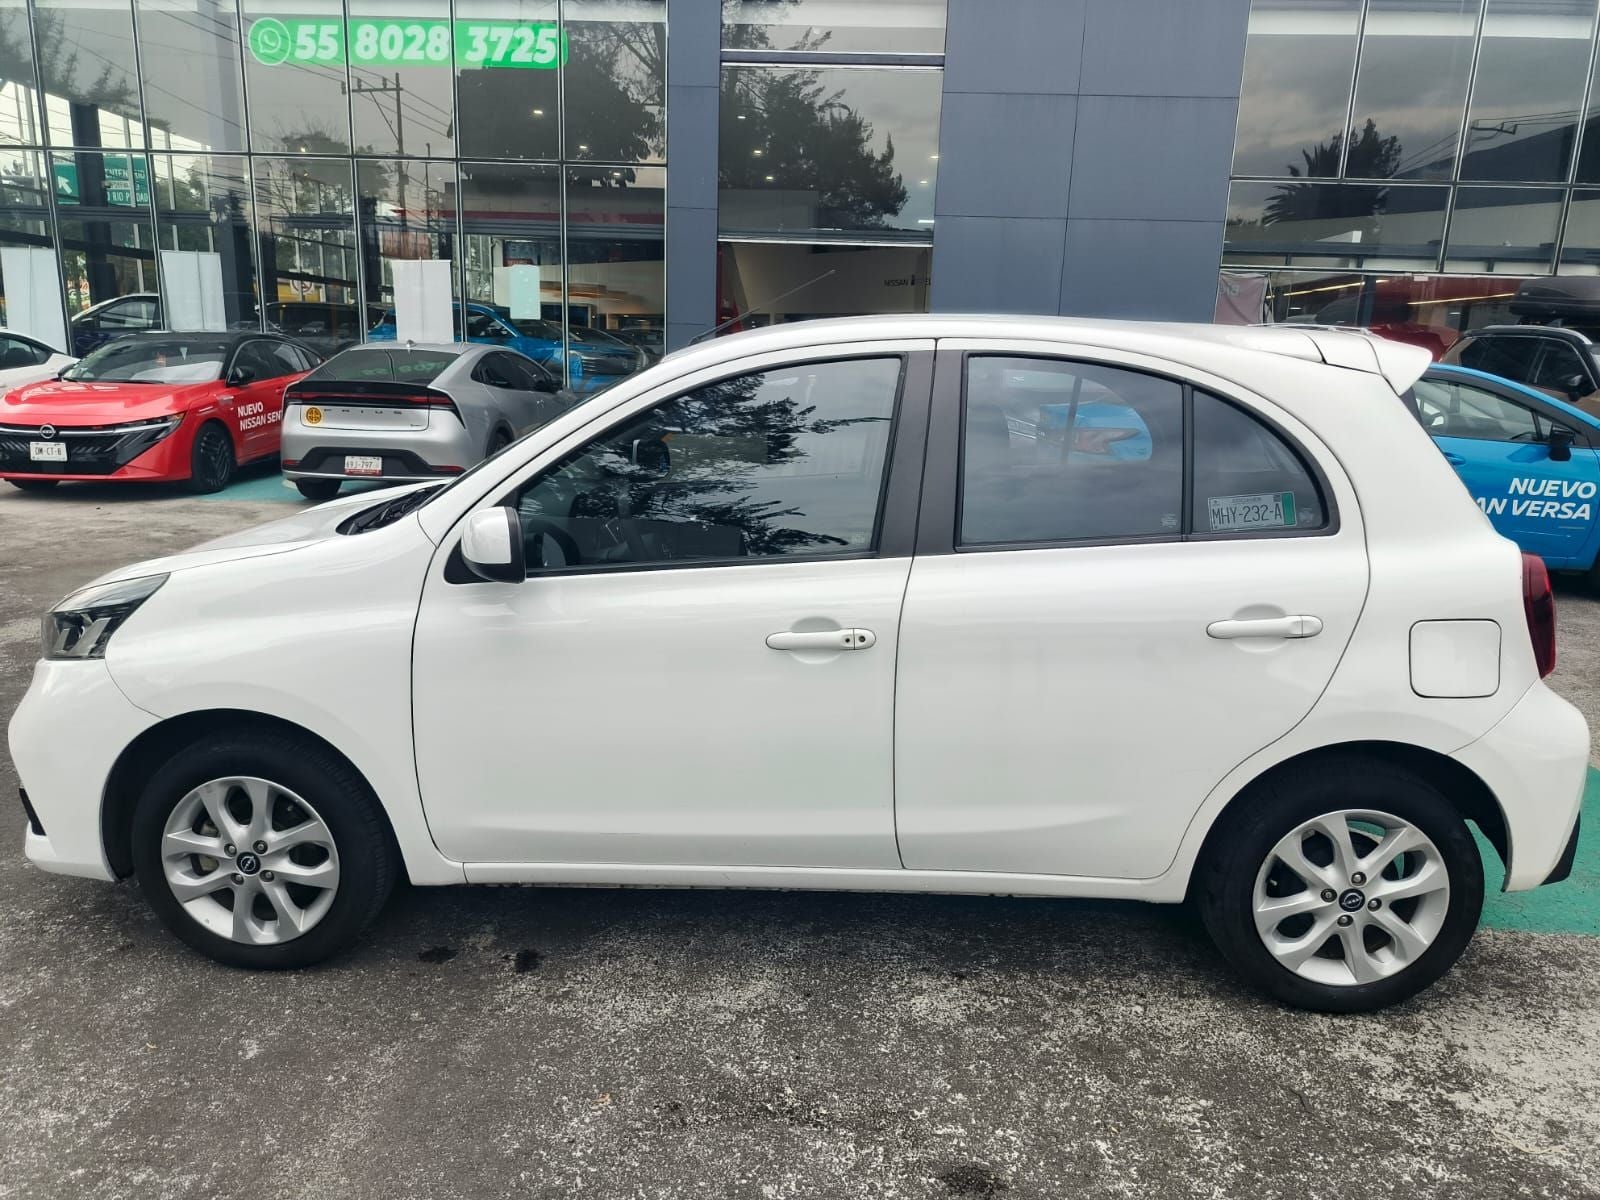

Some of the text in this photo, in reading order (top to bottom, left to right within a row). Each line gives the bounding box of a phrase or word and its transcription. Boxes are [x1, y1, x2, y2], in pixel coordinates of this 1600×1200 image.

[294, 24, 557, 63] 55 8028 3725
[237, 401, 264, 418] NUEVO
[240, 414, 267, 431] NISSAN
[1508, 477, 1597, 499] NUEVO
[1211, 503, 1282, 525] MHY-232-A
[1512, 499, 1591, 521] VERSA
